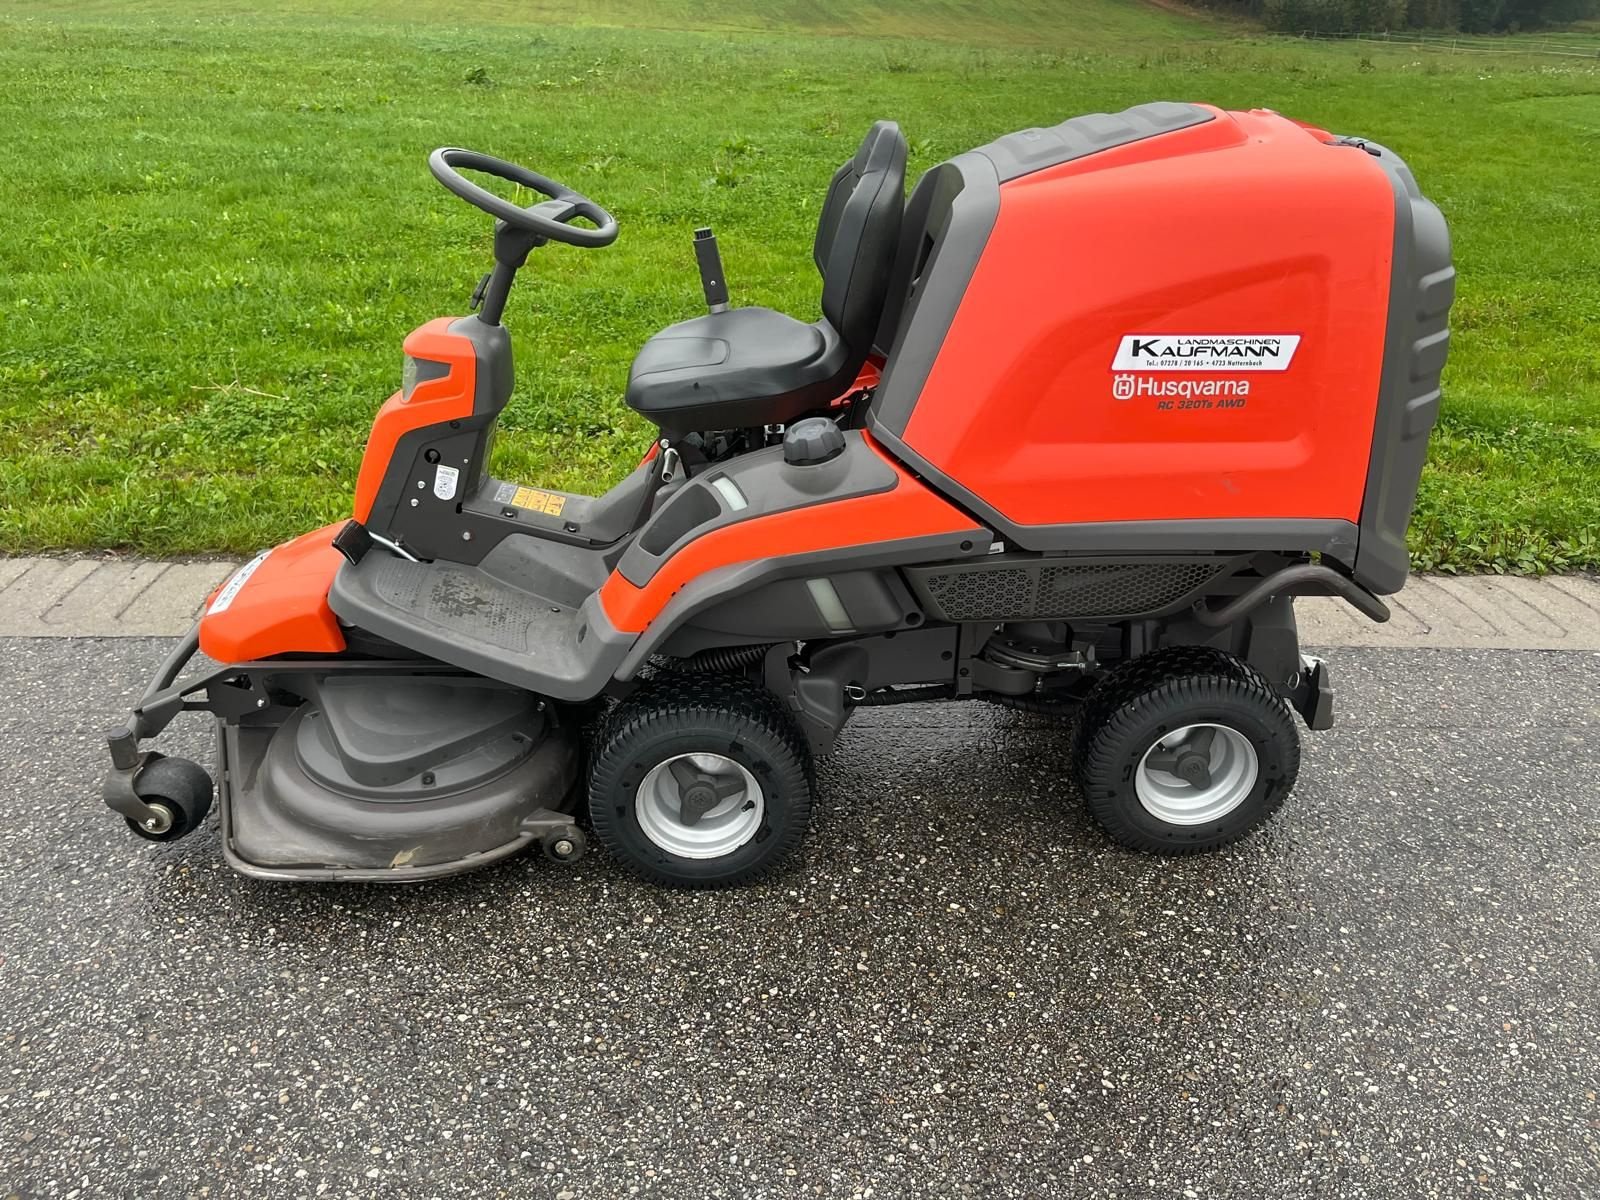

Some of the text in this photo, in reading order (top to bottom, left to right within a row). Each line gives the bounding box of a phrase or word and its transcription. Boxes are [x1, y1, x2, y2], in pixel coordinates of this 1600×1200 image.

[1131, 339, 1280, 357] KAUFMANN
[1146, 359, 1159, 367] Tel.:
[1160, 359, 1178, 367] 07278
[1184, 359, 1192, 367] 20
[1193, 359, 1204, 367] 165
[1211, 359, 1226, 367] 4723
[1227, 359, 1263, 367] Natternbach
[1136, 376, 1250, 398] Husqvarna
[1157, 399, 1246, 410] RC 320Ts AWD
